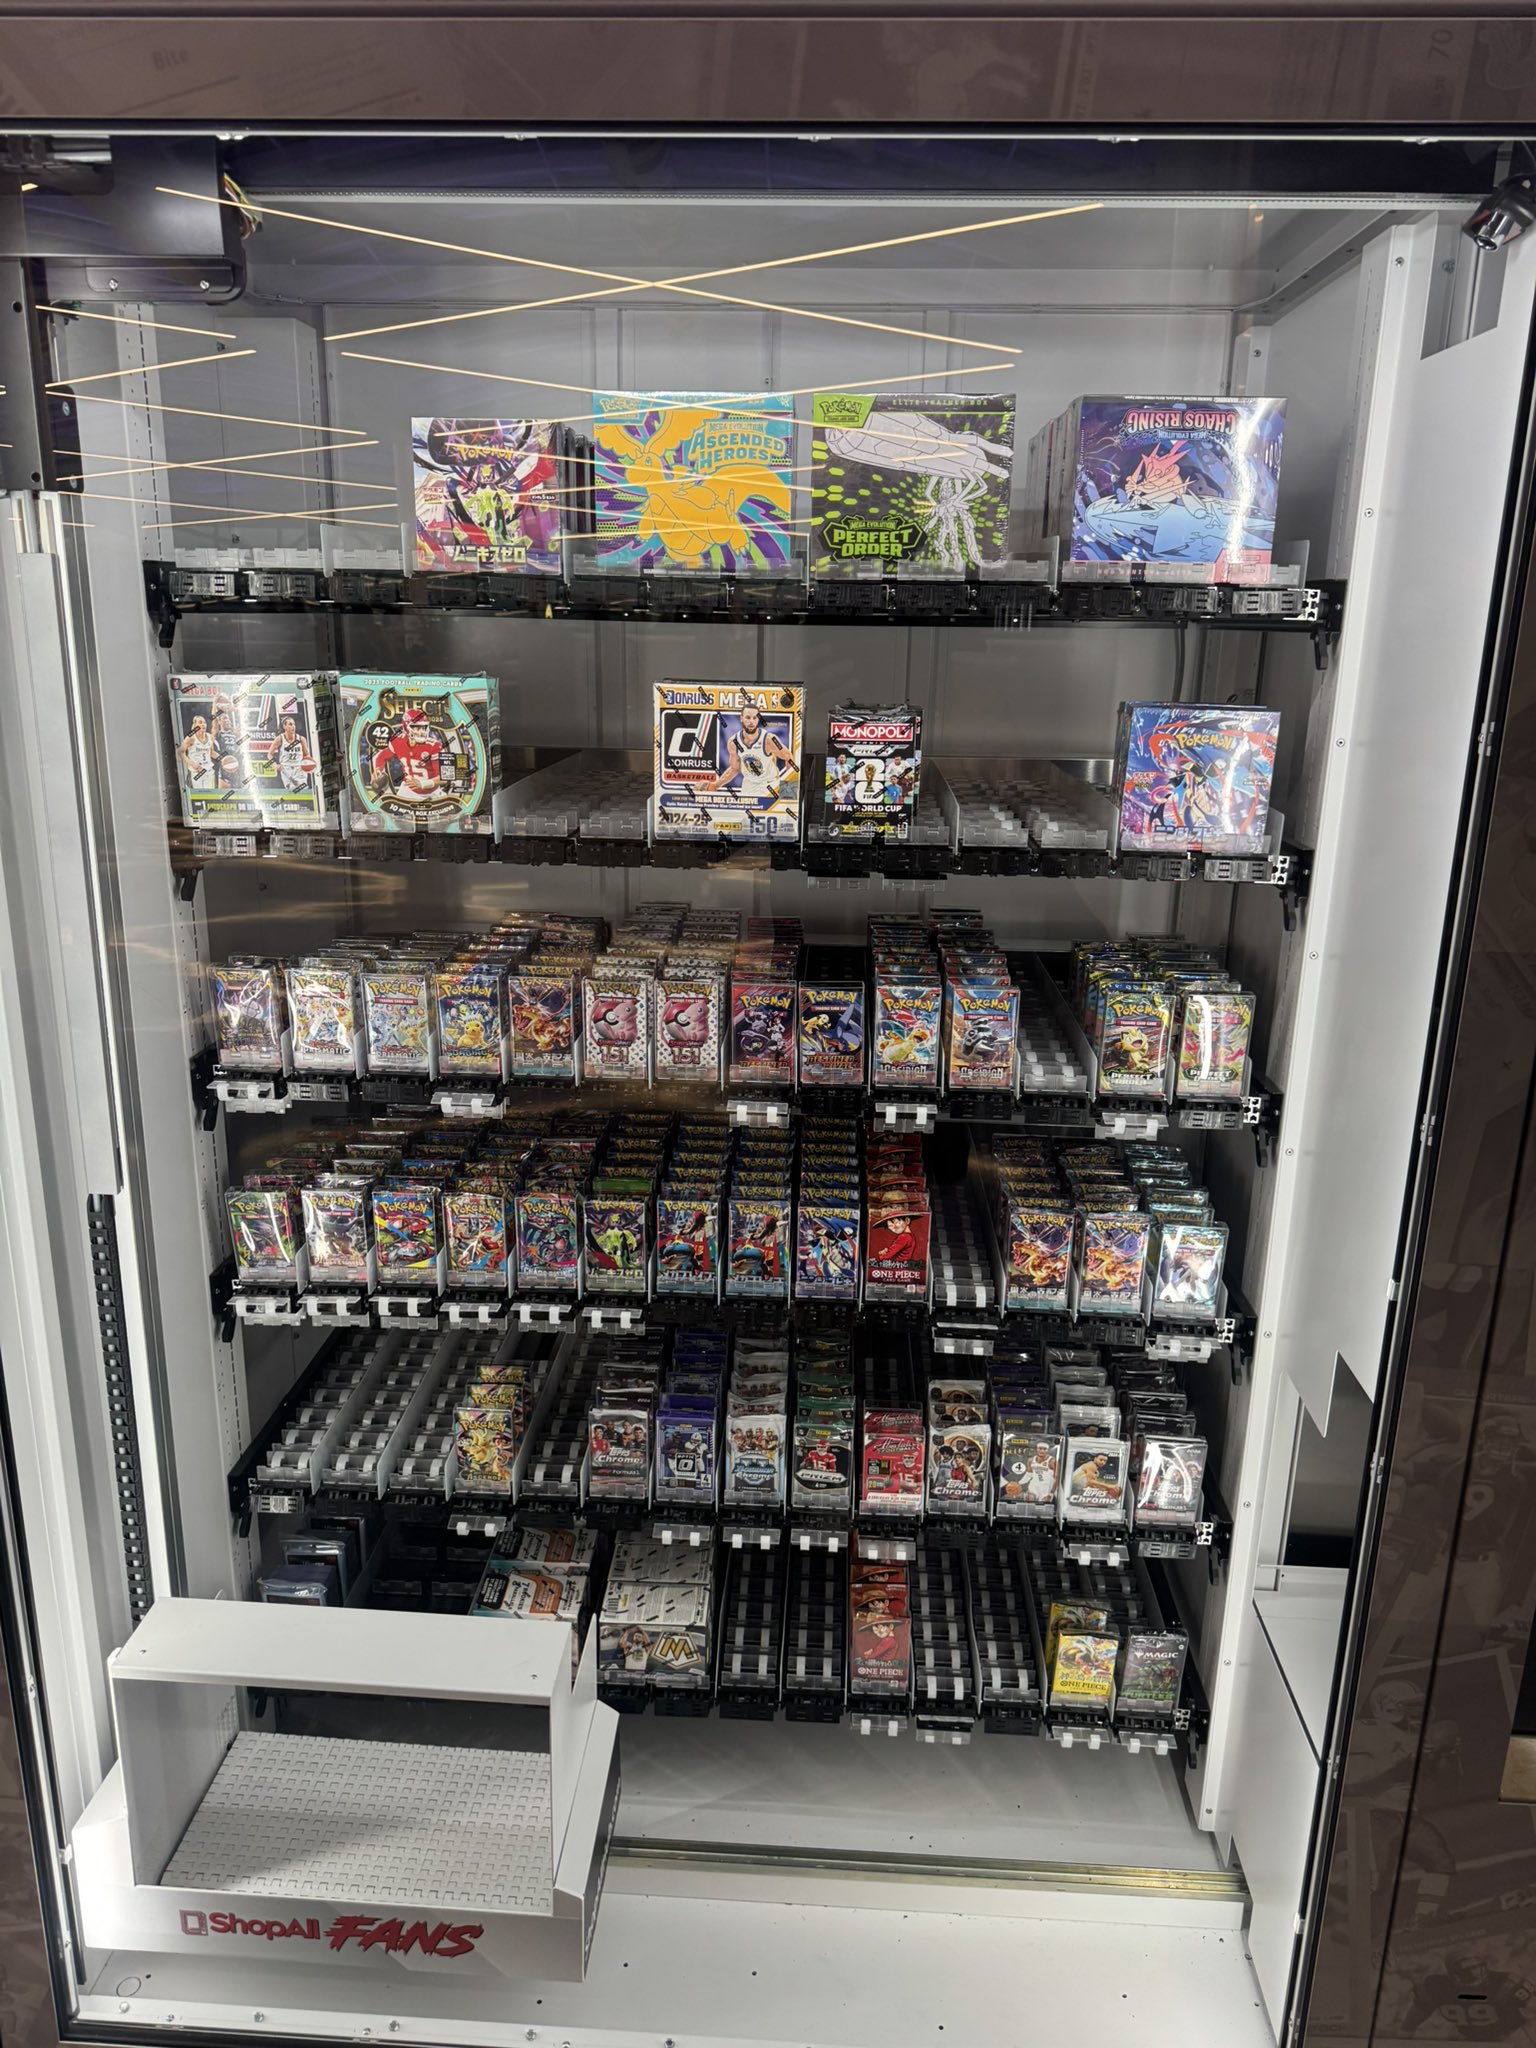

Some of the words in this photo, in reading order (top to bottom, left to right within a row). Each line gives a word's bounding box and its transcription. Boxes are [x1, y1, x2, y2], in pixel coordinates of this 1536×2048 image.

[1127, 411, 1182, 434] RISING
[1184, 411, 1238, 435] CHAOS
[691, 432, 786, 455] ASCENDED
[700, 447, 769, 469] HEROES
[833, 528, 913, 544] PERFECT
[841, 543, 903, 558] ORDER
[372, 726, 390, 738] 42
[834, 725, 911, 739] MONOPOLY
[666, 773, 715, 781] BASKETBALL
[834, 804, 854, 812] FIFA
[740, 996, 792, 1009] Pokémon
[806, 990, 857, 1004] Pokémon
[672, 1046, 702, 1064] 151
[871, 1269, 894, 1280] ONE
[895, 1269, 921, 1280] PIECE
[933, 1487, 980, 1497] Chrome
[1070, 1496, 1118, 1505] Chrome
[1142, 1651, 1180, 1660] MAGIC
[1082, 1681, 1107, 1691] PIECE
[208, 1912, 321, 1940] ShopAll
[323, 1914, 485, 1958] FANS
